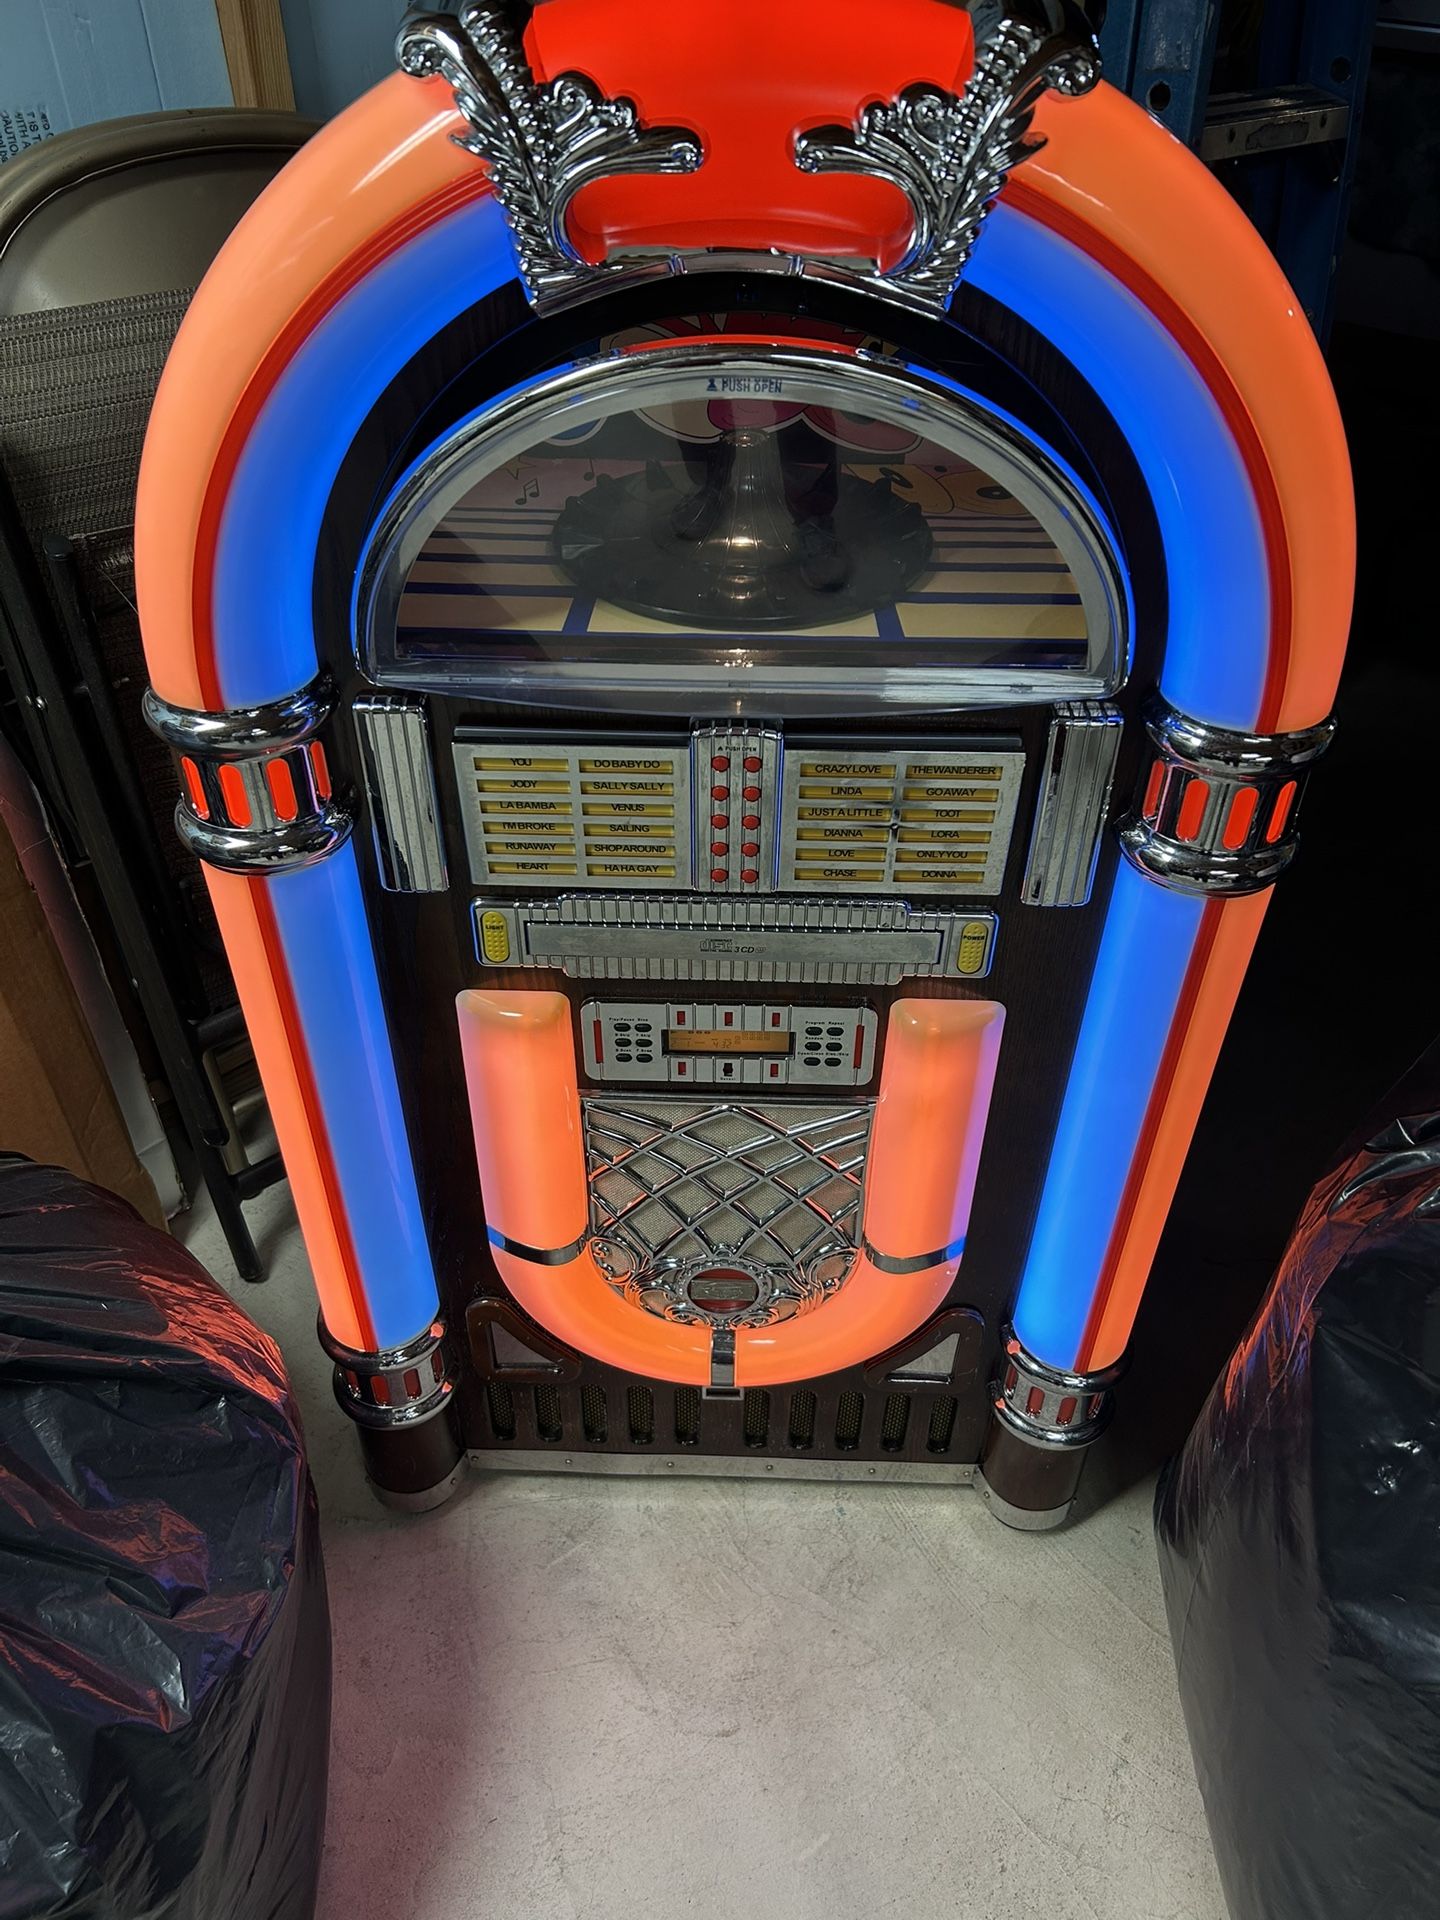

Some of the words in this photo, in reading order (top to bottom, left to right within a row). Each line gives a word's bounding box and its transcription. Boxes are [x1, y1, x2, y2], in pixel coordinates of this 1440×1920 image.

[721, 380, 750, 392] PUSH
[753, 381, 782, 393] OPEN
[510, 758, 532, 767] YOU
[594, 760, 611, 768] DO
[612, 760, 642, 769] BABY
[644, 761, 660, 769] DO
[815, 764, 852, 773] CRAZY
[853, 764, 882, 774] LOVE
[510, 780, 538, 789] JODY
[593, 781, 628, 790] SALLY
[630, 782, 665, 791] SALLY
[831, 786, 862, 795] LINDA
[499, 801, 514, 809] LA
[515, 802, 556, 810] BAMBA
[611, 803, 645, 811] VENUS
[808, 807, 838, 816] JUST
[837, 808, 846, 816] A
[847, 808, 883, 817] LITTLE
[934, 809, 962, 817] TOOT
[517, 823, 556, 831] BROKE
[609, 824, 650, 832] SAILING
[824, 829, 863, 837] DIANNA
[931, 830, 960, 838] LORA
[505, 842, 556, 850] RUNAWAY
[829, 849, 855, 857] LOVE
[516, 862, 549, 870] HEART
[604, 864, 620, 872] HA
[636, 865, 660, 873] GAY
[823, 869, 857, 877] CHASE
[921, 870, 957, 878] DONNA
